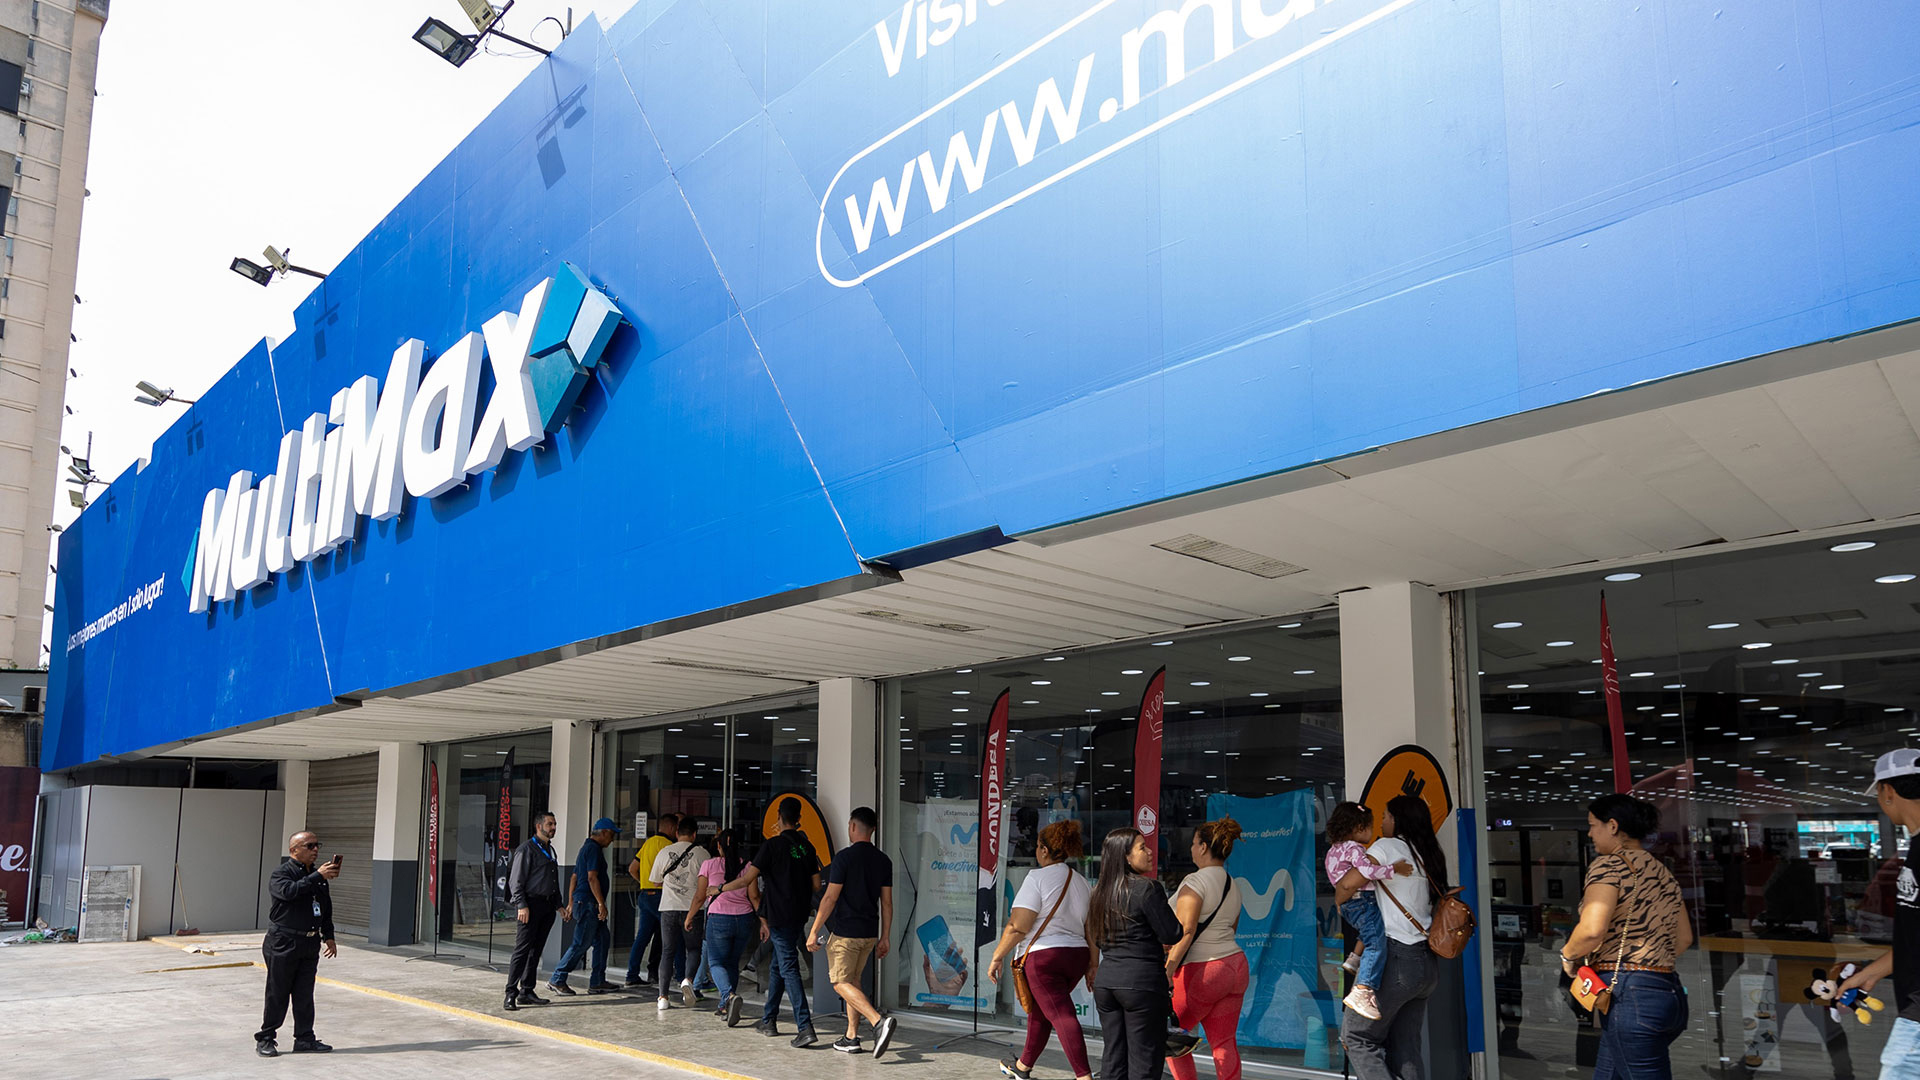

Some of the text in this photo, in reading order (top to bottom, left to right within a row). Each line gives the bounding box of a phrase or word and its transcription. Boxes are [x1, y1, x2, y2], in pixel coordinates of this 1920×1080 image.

[189, 277, 556, 614] MultiMax
[117, 601, 127, 622] en
[143, 572, 165, 610] lugar!
